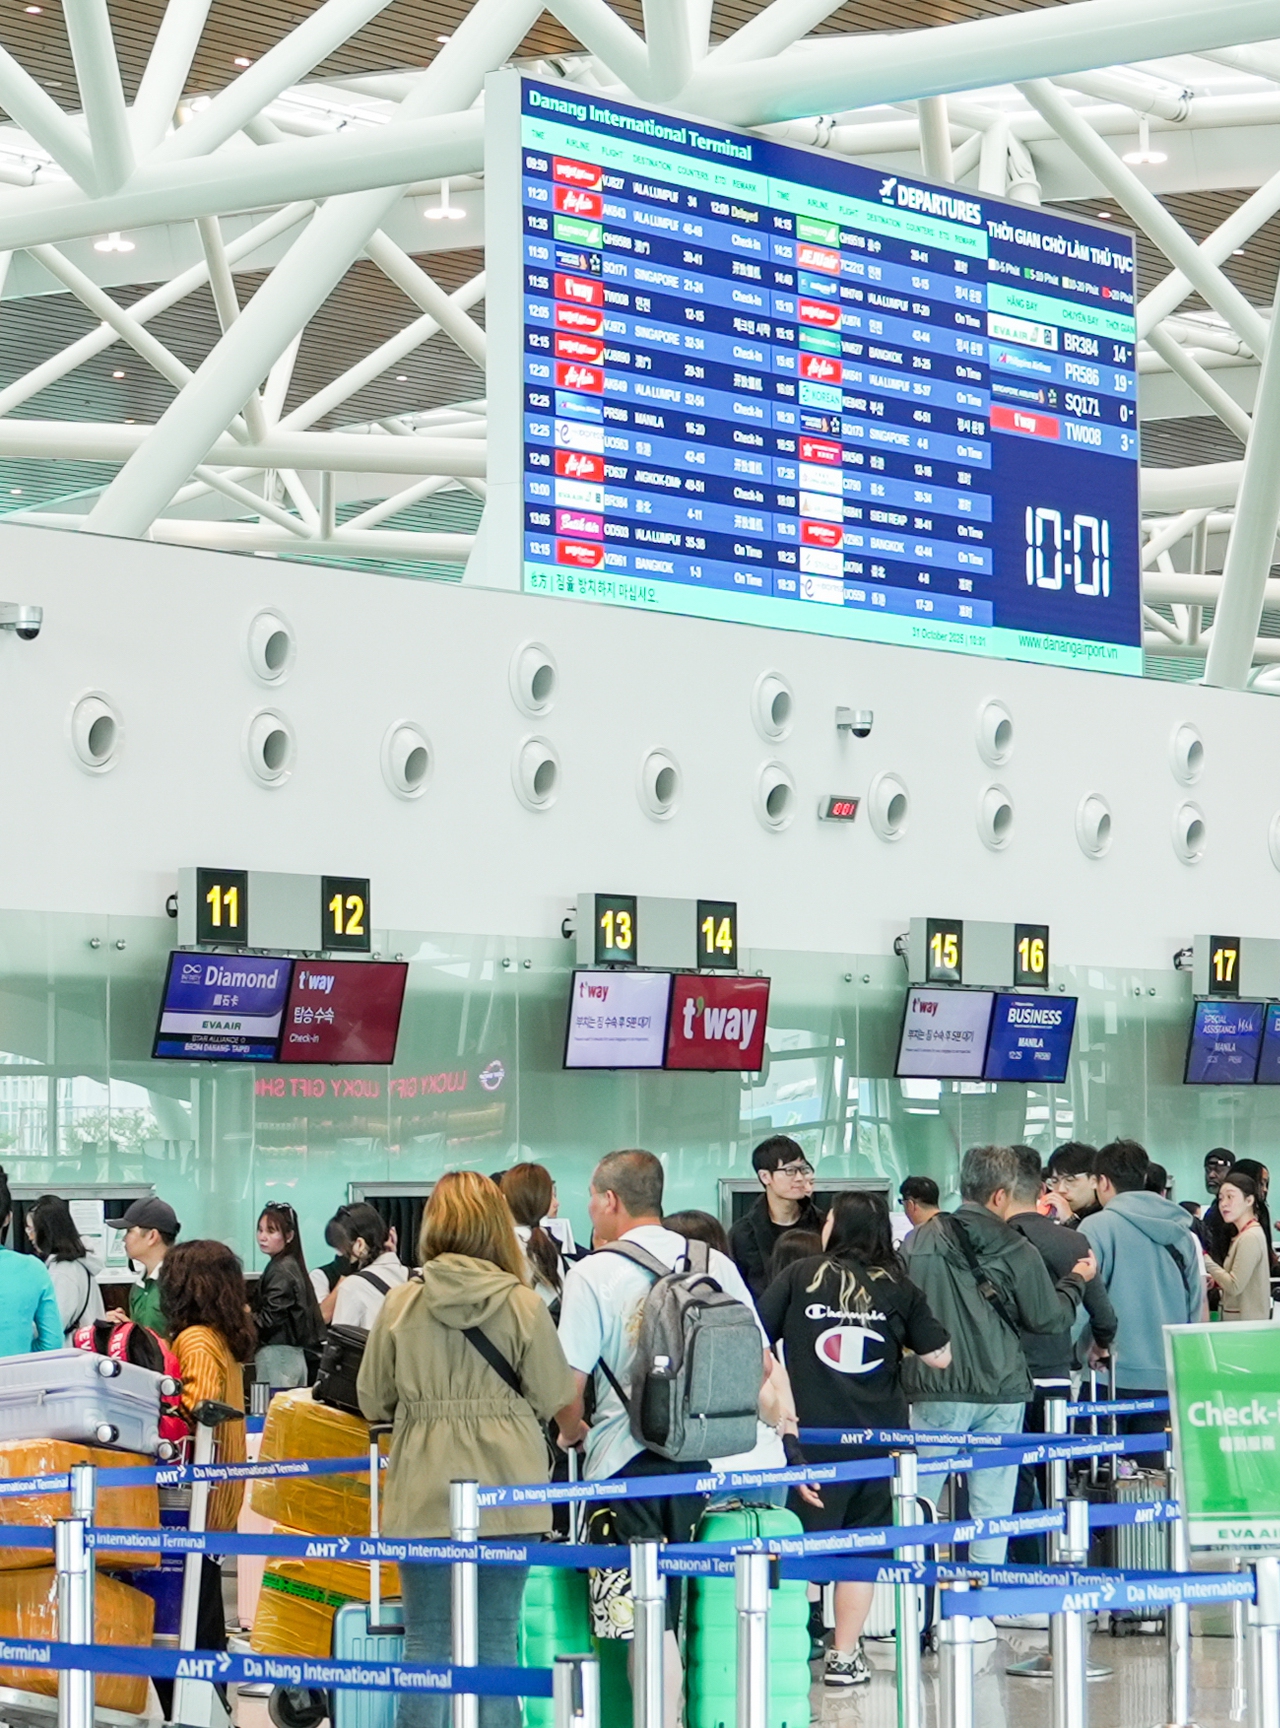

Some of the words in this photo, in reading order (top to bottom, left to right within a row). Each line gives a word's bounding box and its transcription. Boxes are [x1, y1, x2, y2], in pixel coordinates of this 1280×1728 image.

[528, 89, 587, 121] Danang
[589, 105, 687, 144] International
[688, 130, 752, 162] Terminal
[602, 146, 624, 159] FLIGHT
[633, 154, 672, 171] DESTINATION
[897, 184, 981, 226] DEPARTURES
[986, 220, 1014, 243] THỜI
[1014, 228, 1041, 250] GIAN
[1042, 234, 1067, 256] CHỜ
[1067, 240, 1090, 262] LÀM
[1090, 246, 1113, 268] THỦ
[1112, 253, 1133, 274] TỤC
[634, 267, 680, 289] SINGAPORE
[634, 325, 680, 346] SINGAPORE
[993, 325, 1011, 336] EVA
[1011, 328, 1028, 339] AIR
[1064, 332, 1099, 357] BR384
[1065, 362, 1100, 387] PR586
[1065, 393, 1101, 417] SQ171
[634, 411, 665, 429] MANILA
[1065, 422, 1102, 446] TW008
[1025, 505, 1110, 598] 10:01
[921, 627, 949, 643] October
[1018, 634, 1118, 660] www.danangairport.vn
[206, 884, 238, 928] 11
[328, 893, 365, 935] 12
[600, 909, 632, 950] 13
[701, 915, 733, 955] 14
[930, 932, 958, 969] 15
[1018, 937, 1045, 973] 16
[204, 965, 279, 989] Diamond
[1213, 948, 1237, 982] 17
[298, 970, 335, 994] t'way
[579, 981, 609, 1002] t'way
[912, 997, 939, 1017] t'way
[1007, 1007, 1063, 1026] BUSINESS
[202, 1020, 222, 1030] EVA
[223, 1022, 242, 1031] AIR
[683, 995, 758, 1051] t'way
[289, 1032, 320, 1044] Check-in
[1018, 1036, 1044, 1048] MANILA
[1214, 1042, 1236, 1053] MANILA
[805, 1303, 887, 1324] Champio
[841, 1433, 864, 1444] AHT
[880, 1431, 891, 1442] Da
[892, 1431, 914, 1445] Nang
[915, 1432, 966, 1445] International
[967, 1434, 1002, 1446] Terminal
[155, 1471, 179, 1482] AHT
[193, 1468, 204, 1479] Da
[205, 1468, 228, 1480] Nang
[229, 1465, 274, 1478] International
[275, 1462, 309, 1474] Terminal
[97, 1534, 161, 1548] International
[162, 1534, 206, 1549] Terminal
[1218, 1528, 1252, 1539] EVA
[305, 1542, 338, 1558] AHT
[360, 1540, 375, 1554] Da
[376, 1541, 406, 1558] Nang
[408, 1544, 478, 1559] International
[479, 1546, 527, 1561] Terminal
[176, 1658, 216, 1677] AHT
[243, 1659, 263, 1676] Da
[265, 1661, 302, 1682] Nang
[303, 1663, 390, 1685] International
[392, 1667, 452, 1689] Terminal
